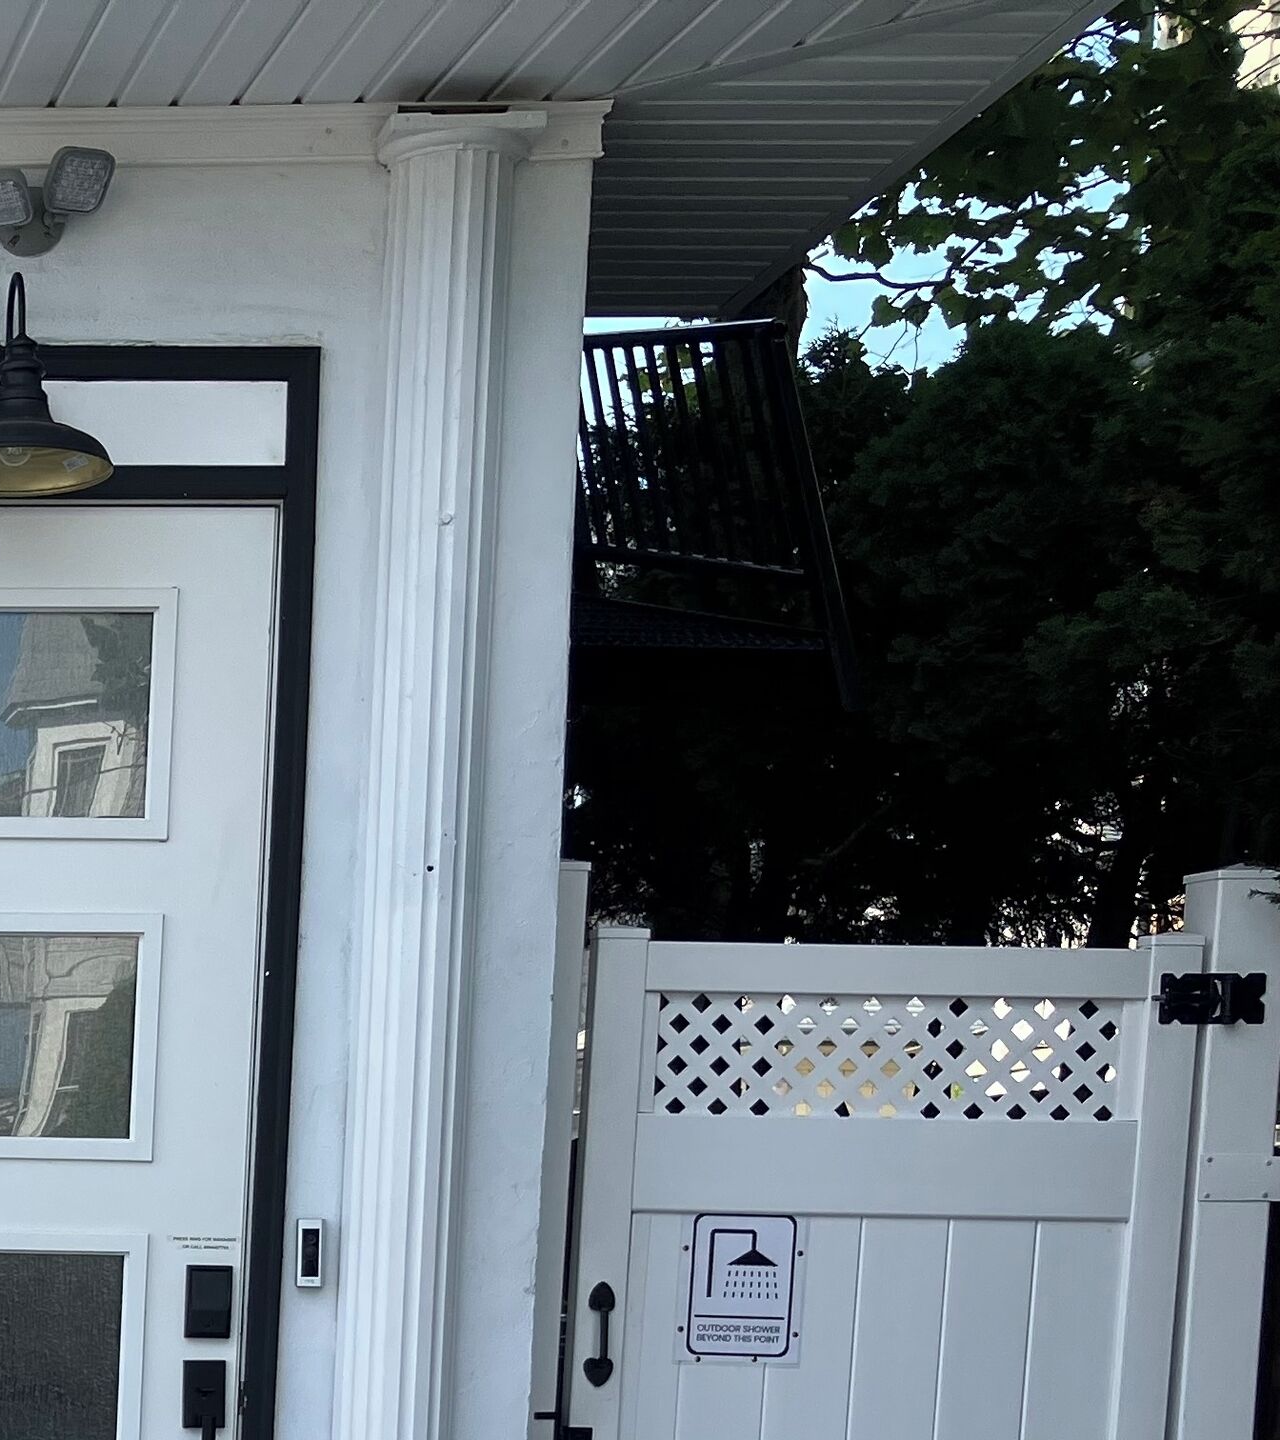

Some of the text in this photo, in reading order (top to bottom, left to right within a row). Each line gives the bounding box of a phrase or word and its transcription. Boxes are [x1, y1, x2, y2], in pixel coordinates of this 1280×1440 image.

[696, 1323, 781, 1334] OUTDOOR SHOWER
[695, 1333, 780, 1344] BEYOND THIS POINT
